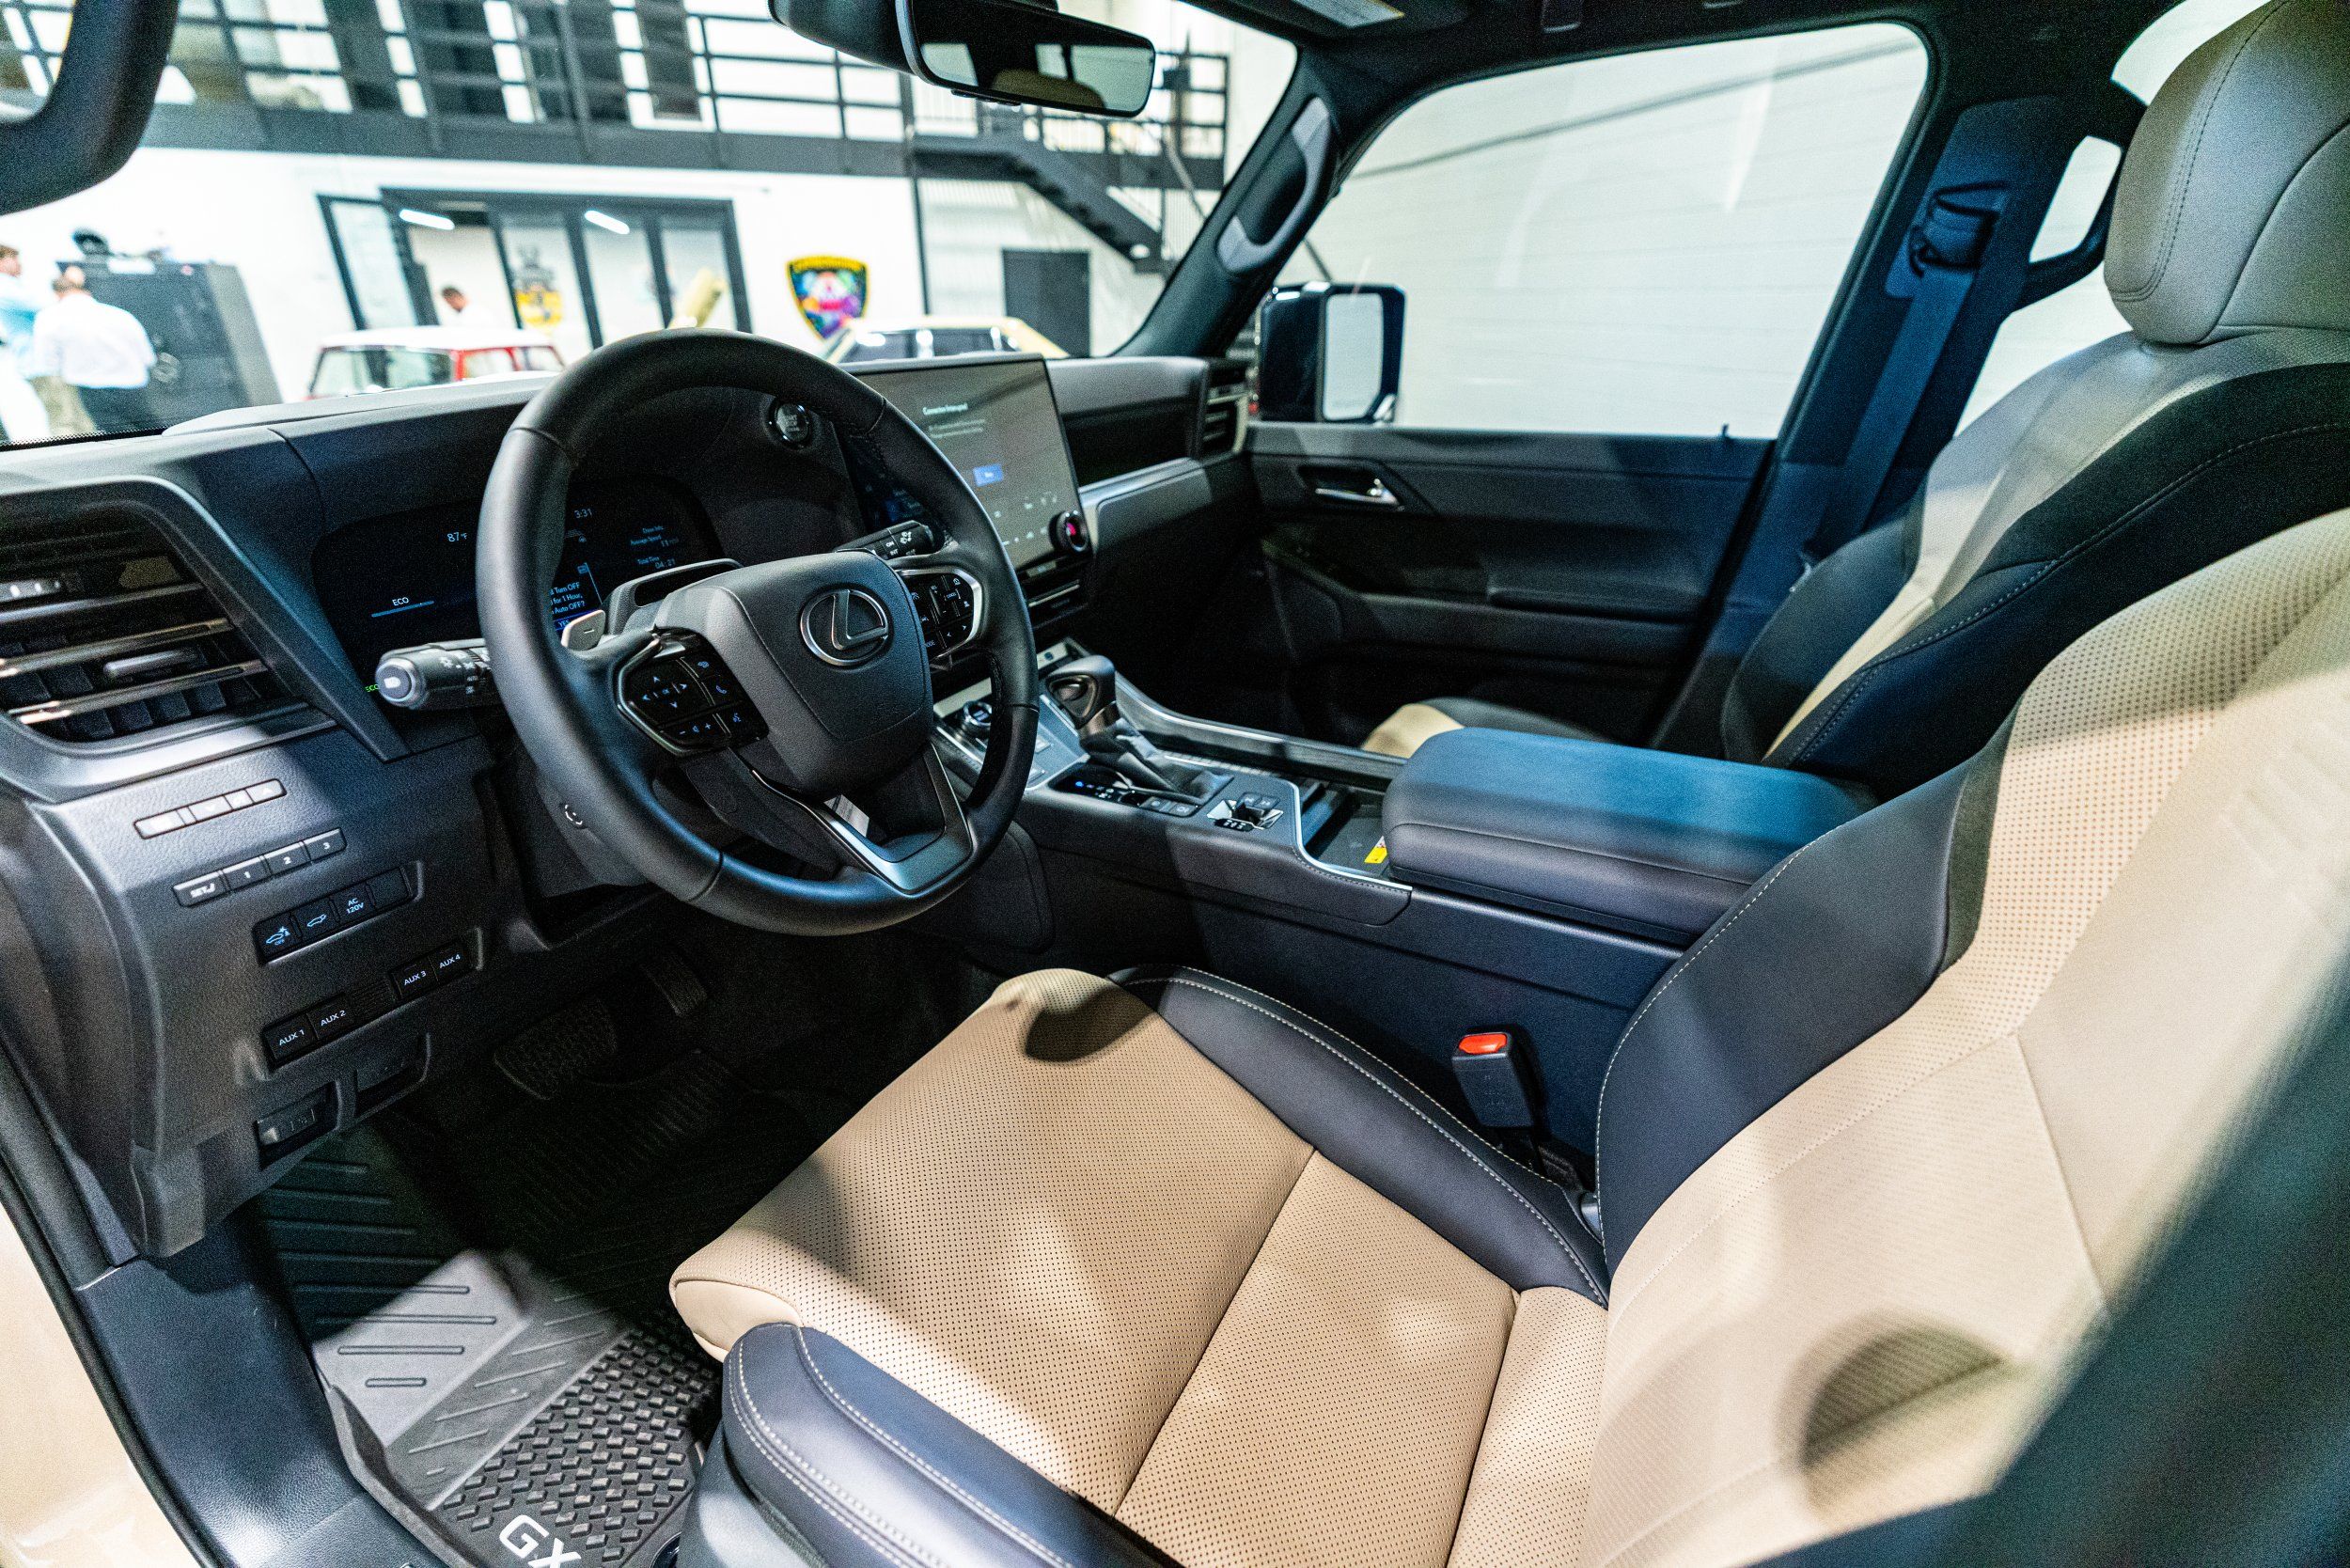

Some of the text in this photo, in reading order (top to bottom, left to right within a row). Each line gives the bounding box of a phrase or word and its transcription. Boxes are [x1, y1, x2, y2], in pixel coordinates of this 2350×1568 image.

[574, 509, 593, 519] 3:31
[567, 582, 580, 590] OFF
[392, 596, 410, 606] ECO
[569, 600, 585, 610] OFF?
[322, 841, 331, 850] 3
[283, 856, 291, 865] 2
[243, 870, 251, 880] 1
[348, 898, 358, 906] AC
[346, 902, 364, 914] 120V
[438, 953, 462, 969] AUX 4
[403, 973, 420, 986] AUX
[320, 1012, 339, 1027] AUX
[278, 1032, 299, 1046] AUX
[499, 1514, 582, 1568] GX
